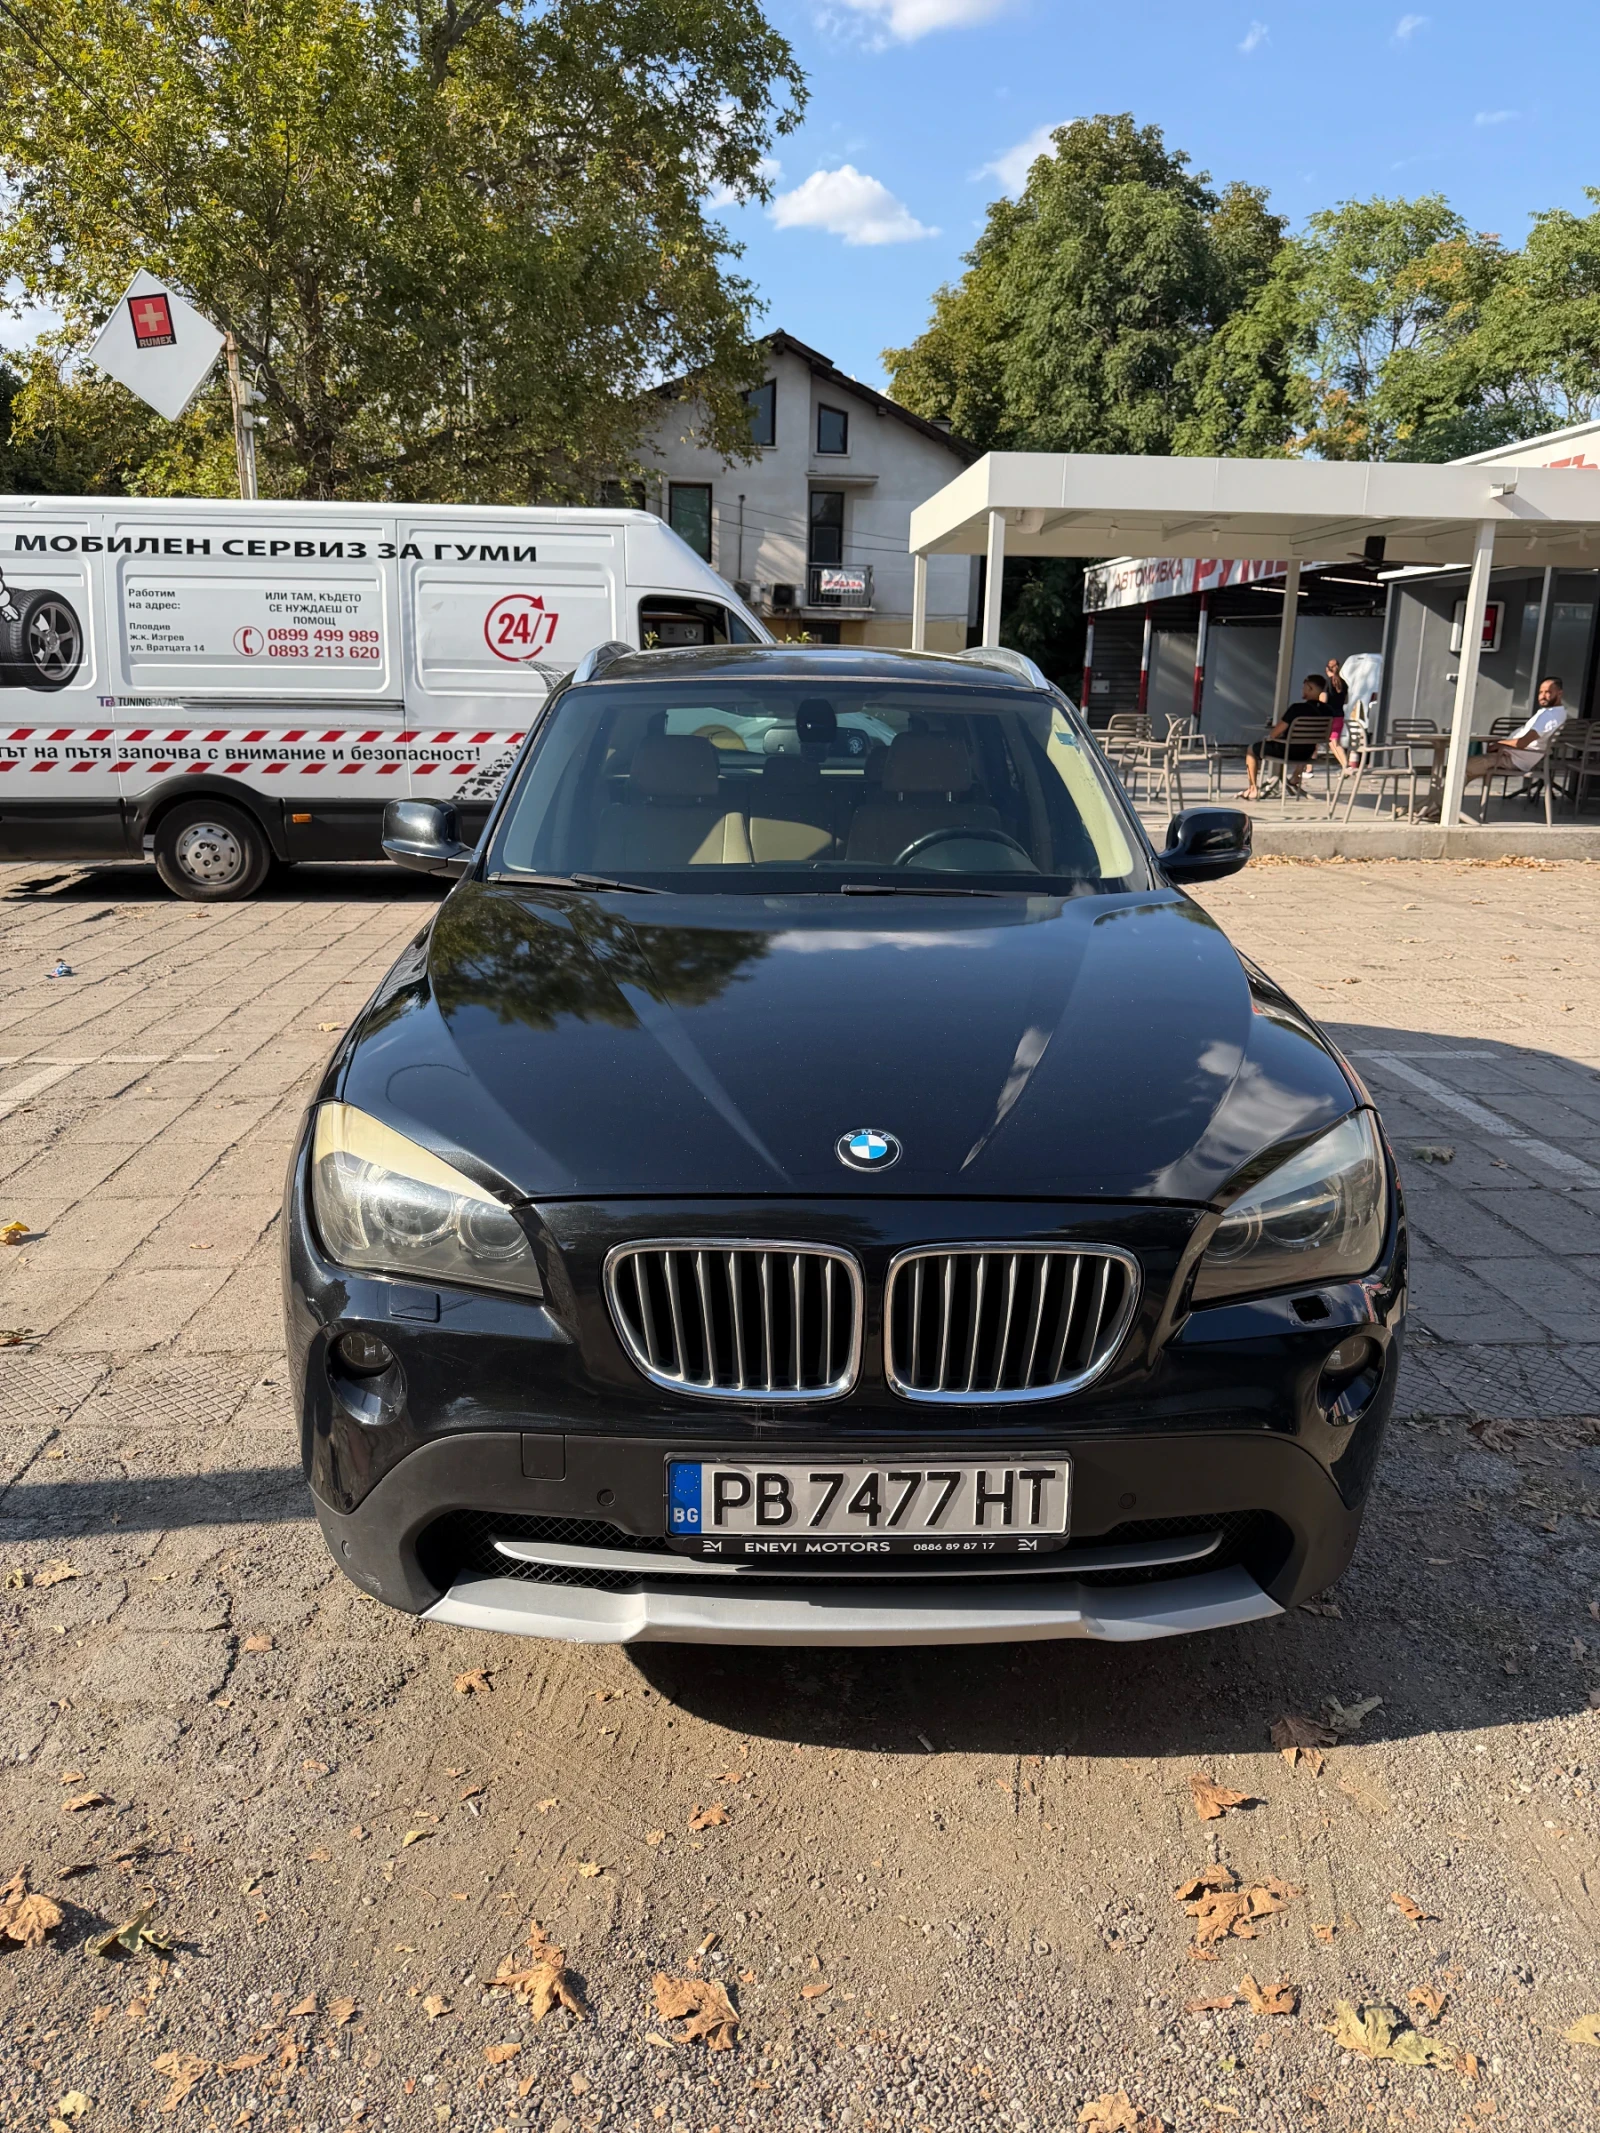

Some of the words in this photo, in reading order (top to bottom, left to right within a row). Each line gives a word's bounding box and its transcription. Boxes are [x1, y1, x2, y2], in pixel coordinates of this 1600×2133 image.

[139, 335, 173, 347] RUMEX
[14, 534, 211, 555] МОБИЛЕН
[222, 539, 367, 558] СЕРВИЗ
[377, 543, 424, 560] ЗА
[434, 544, 537, 562] ГУМИ
[128, 588, 176, 598] Работим
[265, 592, 288, 601] ИЛИ
[290, 592, 317, 602] ТАМ,
[319, 593, 362, 602] КЪДЕТО
[145, 602, 181, 611] адрес:
[269, 604, 283, 613] СЕ
[285, 604, 342, 614] НУЖДАЕШ
[345, 605, 359, 614] ОТ
[129, 622, 171, 631] Пловдив
[293, 616, 336, 626] ПОМОЩ
[497, 613, 559, 644] 24/7
[151, 633, 185, 642] Изгрев
[267, 628, 308, 641] 0899
[313, 629, 344, 642] 499
[348, 630, 379, 643] 989
[130, 644, 144, 652] ул.
[146, 643, 191, 652] Вратцата
[193, 644, 205, 652] 14
[268, 644, 309, 658] 0893
[314, 645, 344, 658] 213
[349, 646, 380, 659] 620
[34, 747, 58, 758] на
[65, 747, 112, 759] пътя
[118, 747, 201, 759] започва
[207, 748, 219, 760] с
[225, 748, 326, 760] внимание
[332, 749, 344, 760] и
[351, 746, 481, 761] безопасност!
[844, 1129, 892, 1141] BMW
[808, 1470, 961, 1527] 7477
[973, 1469, 1056, 1526] HT
[673, 1507, 699, 1523] BG
[744, 1542, 797, 1553] ENEVI
[805, 1541, 891, 1553] MOTORS
[913, 1542, 942, 1551] 0886
[945, 1542, 960, 1551] 89
[963, 1542, 978, 1551] 87
[982, 1541, 996, 1550] 17
